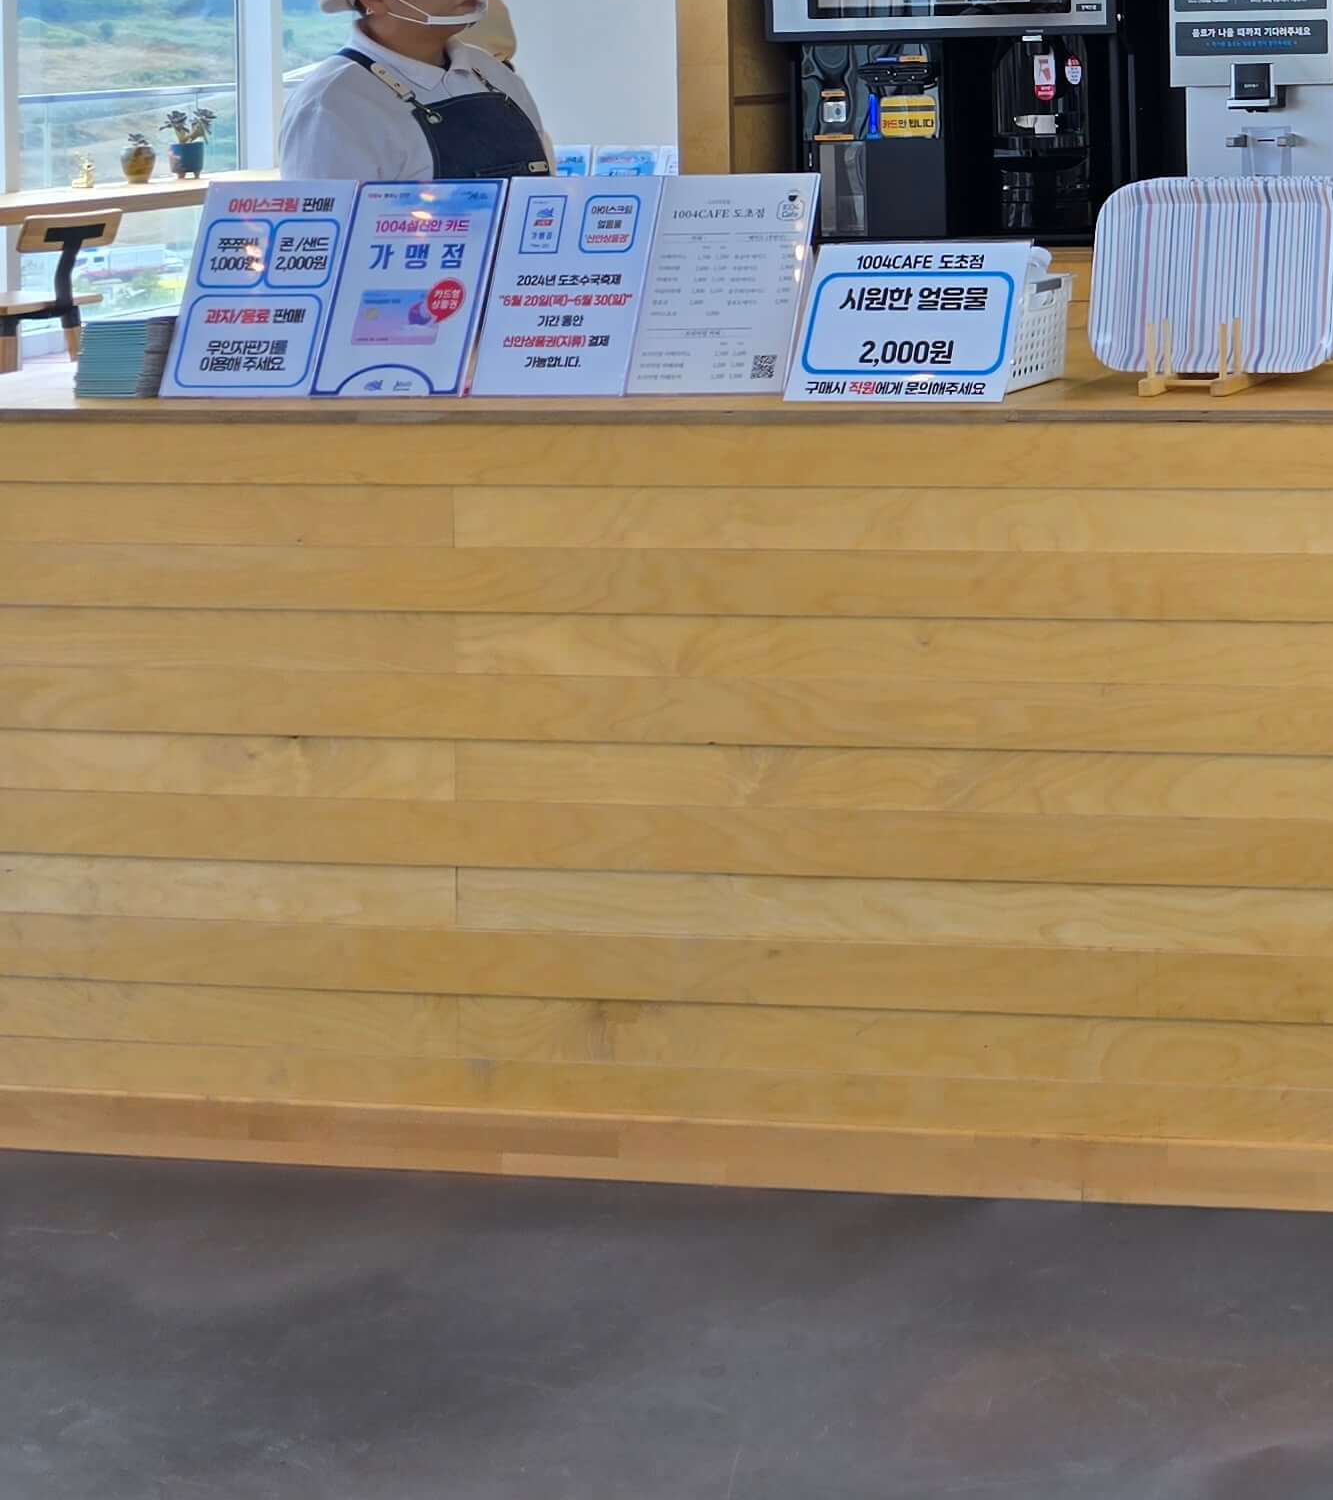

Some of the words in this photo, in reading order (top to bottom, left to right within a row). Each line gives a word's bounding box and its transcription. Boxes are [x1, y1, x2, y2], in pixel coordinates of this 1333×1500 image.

[228, 198, 298, 212] 아이스크림
[302, 197, 335, 212] 판매!
[673, 208, 731, 219] 1004CAFE
[732, 207, 765, 219] 도초점
[445, 220, 470, 232] 카드
[280, 237, 294, 252] 콘
[275, 256, 328, 272] 2,000원
[369, 244, 395, 270] 가
[405, 244, 430, 269] 맹
[441, 244, 465, 269] 점
[857, 255, 933, 270] 1004CAFE
[939, 254, 985, 270] 도초점
[517, 274, 556, 286] 2024년
[557, 274, 622, 286] 도초수국축제
[839, 287, 913, 311] 시원한
[916, 287, 989, 311] 얼음물
[205, 308, 270, 324] 과자/음료
[272, 308, 306, 324] 판매!
[537, 315, 559, 327] 기간
[561, 315, 584, 327] 동안
[207, 340, 288, 355] 무인자판기를
[588, 335, 610, 347] 결제
[859, 340, 954, 368] 2,000원
[200, 356, 242, 372] 이용해
[805, 382, 846, 395] 구매시
[849, 381, 902, 395] 직원에게
[904, 381, 986, 396] 문의해주세요
